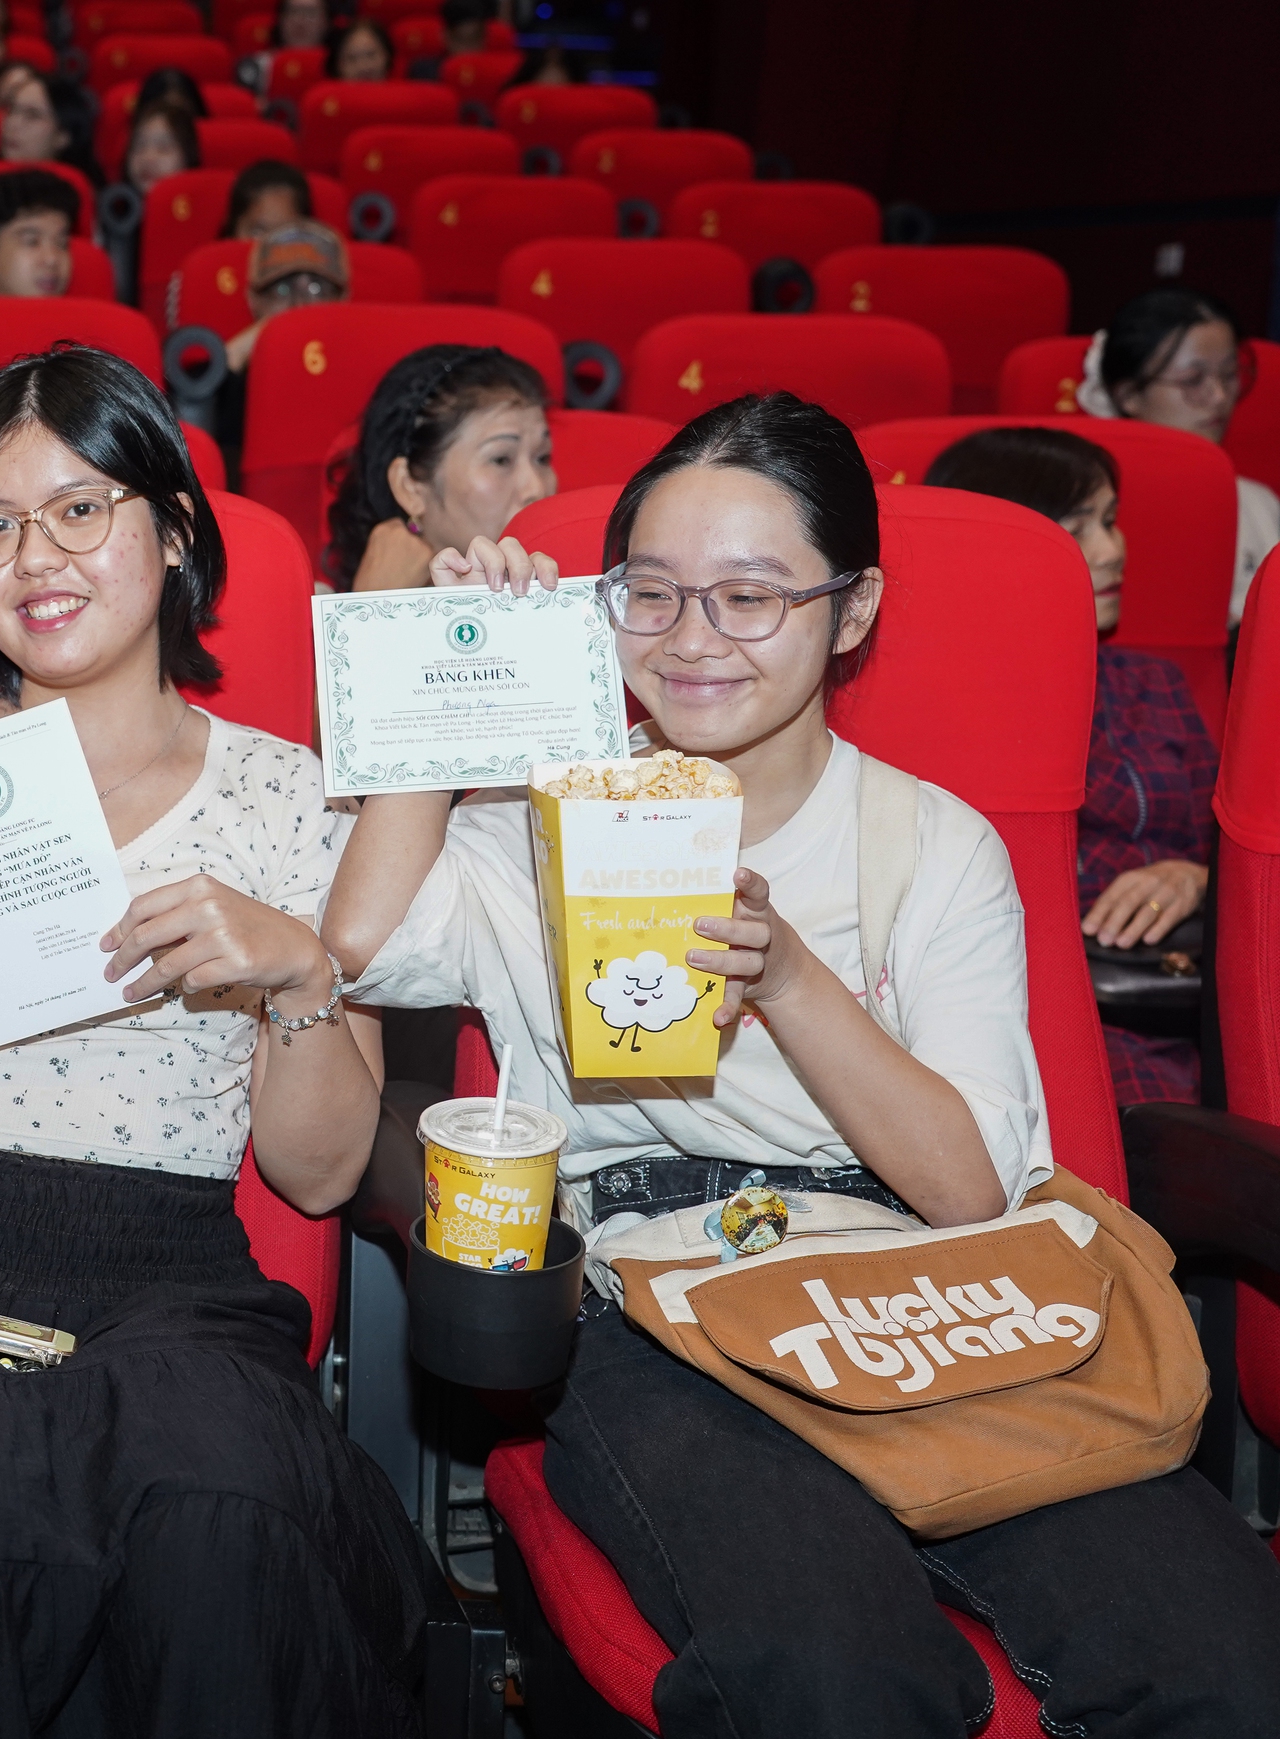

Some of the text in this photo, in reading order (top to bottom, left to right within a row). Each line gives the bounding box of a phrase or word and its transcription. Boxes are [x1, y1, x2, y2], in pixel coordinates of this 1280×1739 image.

[217, 266, 239, 296] 6
[530, 268, 555, 299] 4
[849, 279, 873, 313] 2
[302, 339, 328, 377] 6
[677, 359, 705, 395] 4
[1054, 377, 1078, 413] 2
[473, 668, 515, 681] KHEN
[427, 687, 450, 695] CHÚC
[452, 685, 477, 693] MỪNG
[478, 684, 495, 692] BẠN
[12, 820, 28, 829] LONG
[3, 847, 30, 861] NHÂN
[31, 840, 50, 851] VẬT
[53, 834, 71, 845] SEN
[12, 873, 32, 885] CẬN
[34, 864, 61, 878] NHÂN
[63, 857, 83, 868] VĂN
[22, 878, 58, 894] TƯỢNG
[59, 867, 91, 883] NGƯỜI
[578, 866, 722, 891] AWESOME
[5, 902, 19, 913] VÀ
[20, 897, 39, 909] SAU
[41, 888, 67, 902] CUỘC
[70, 878, 100, 893] CHIẾN
[579, 910, 623, 931] Fresh
[627, 905, 657, 930] and
[458, 1166, 496, 1179] GALAXY
[479, 1182, 531, 1204] HOW
[454, 1192, 542, 1226] GREAT!
[458, 1252, 482, 1263] STAR
